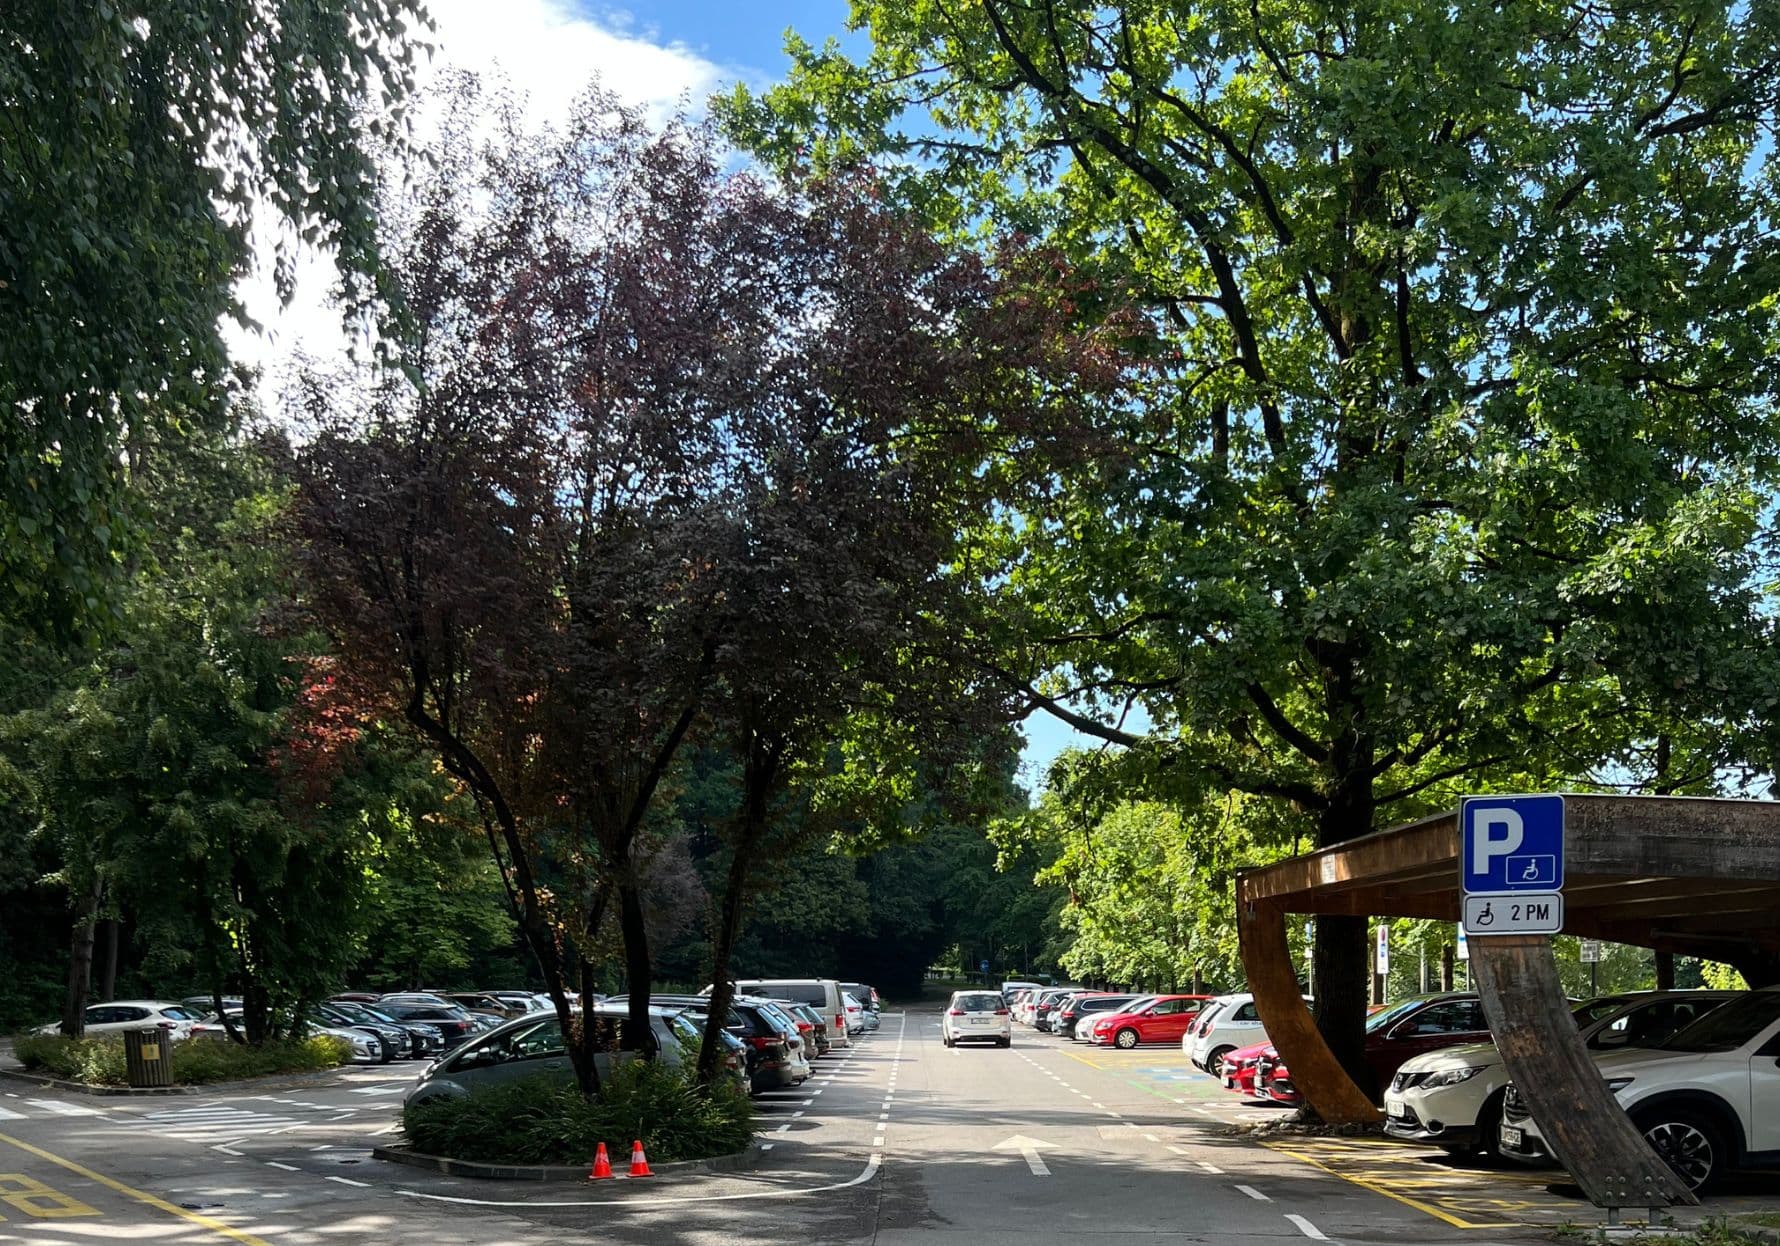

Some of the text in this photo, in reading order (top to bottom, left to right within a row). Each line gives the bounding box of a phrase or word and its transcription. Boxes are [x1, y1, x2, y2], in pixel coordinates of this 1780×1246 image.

[1473, 808, 1524, 874] P
[1511, 904, 1549, 921] 2 PM
